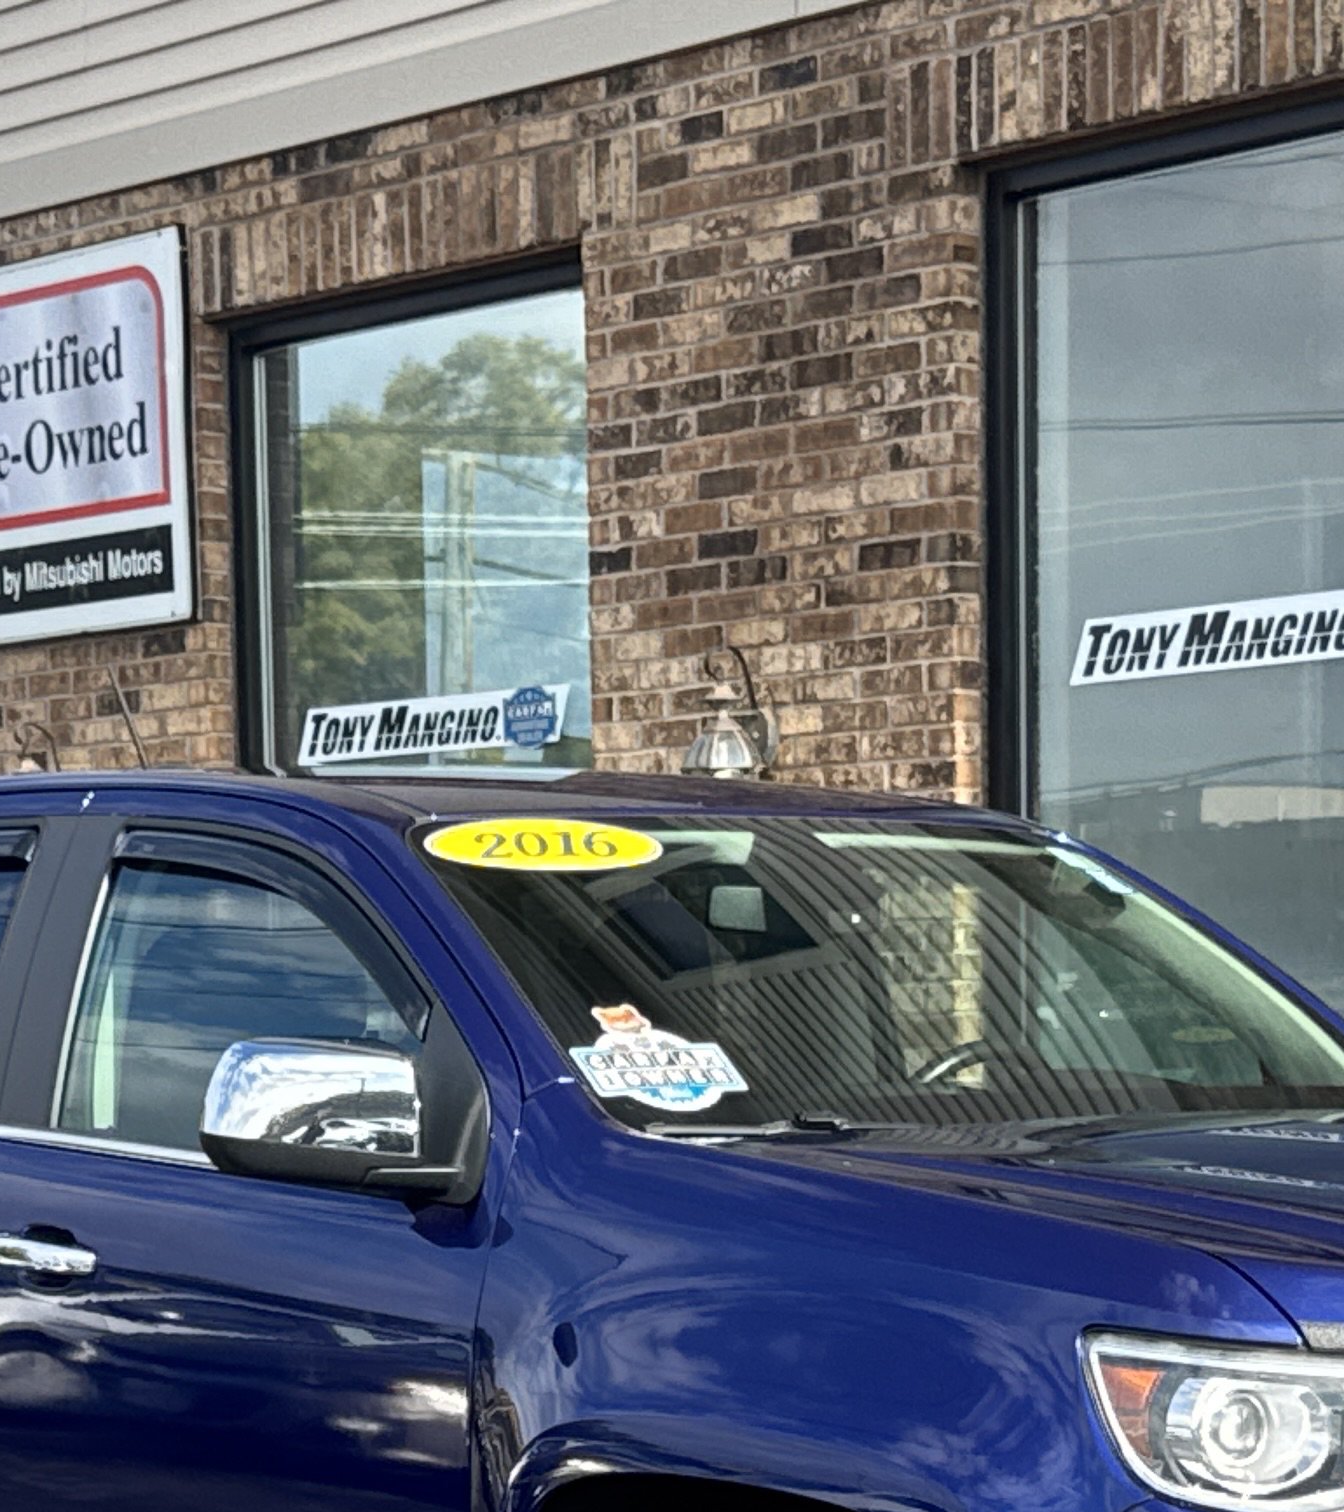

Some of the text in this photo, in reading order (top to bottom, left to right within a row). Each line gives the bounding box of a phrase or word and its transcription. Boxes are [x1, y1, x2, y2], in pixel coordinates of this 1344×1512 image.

[2, 565, 22, 602] by
[24, 550, 104, 592] Mitsubishi
[107, 548, 164, 581] Motors
[1082, 623, 1180, 676] TONY
[308, 713, 375, 757] TONY
[374, 705, 500, 752] MANGINO
[473, 831, 619, 860] 2016
